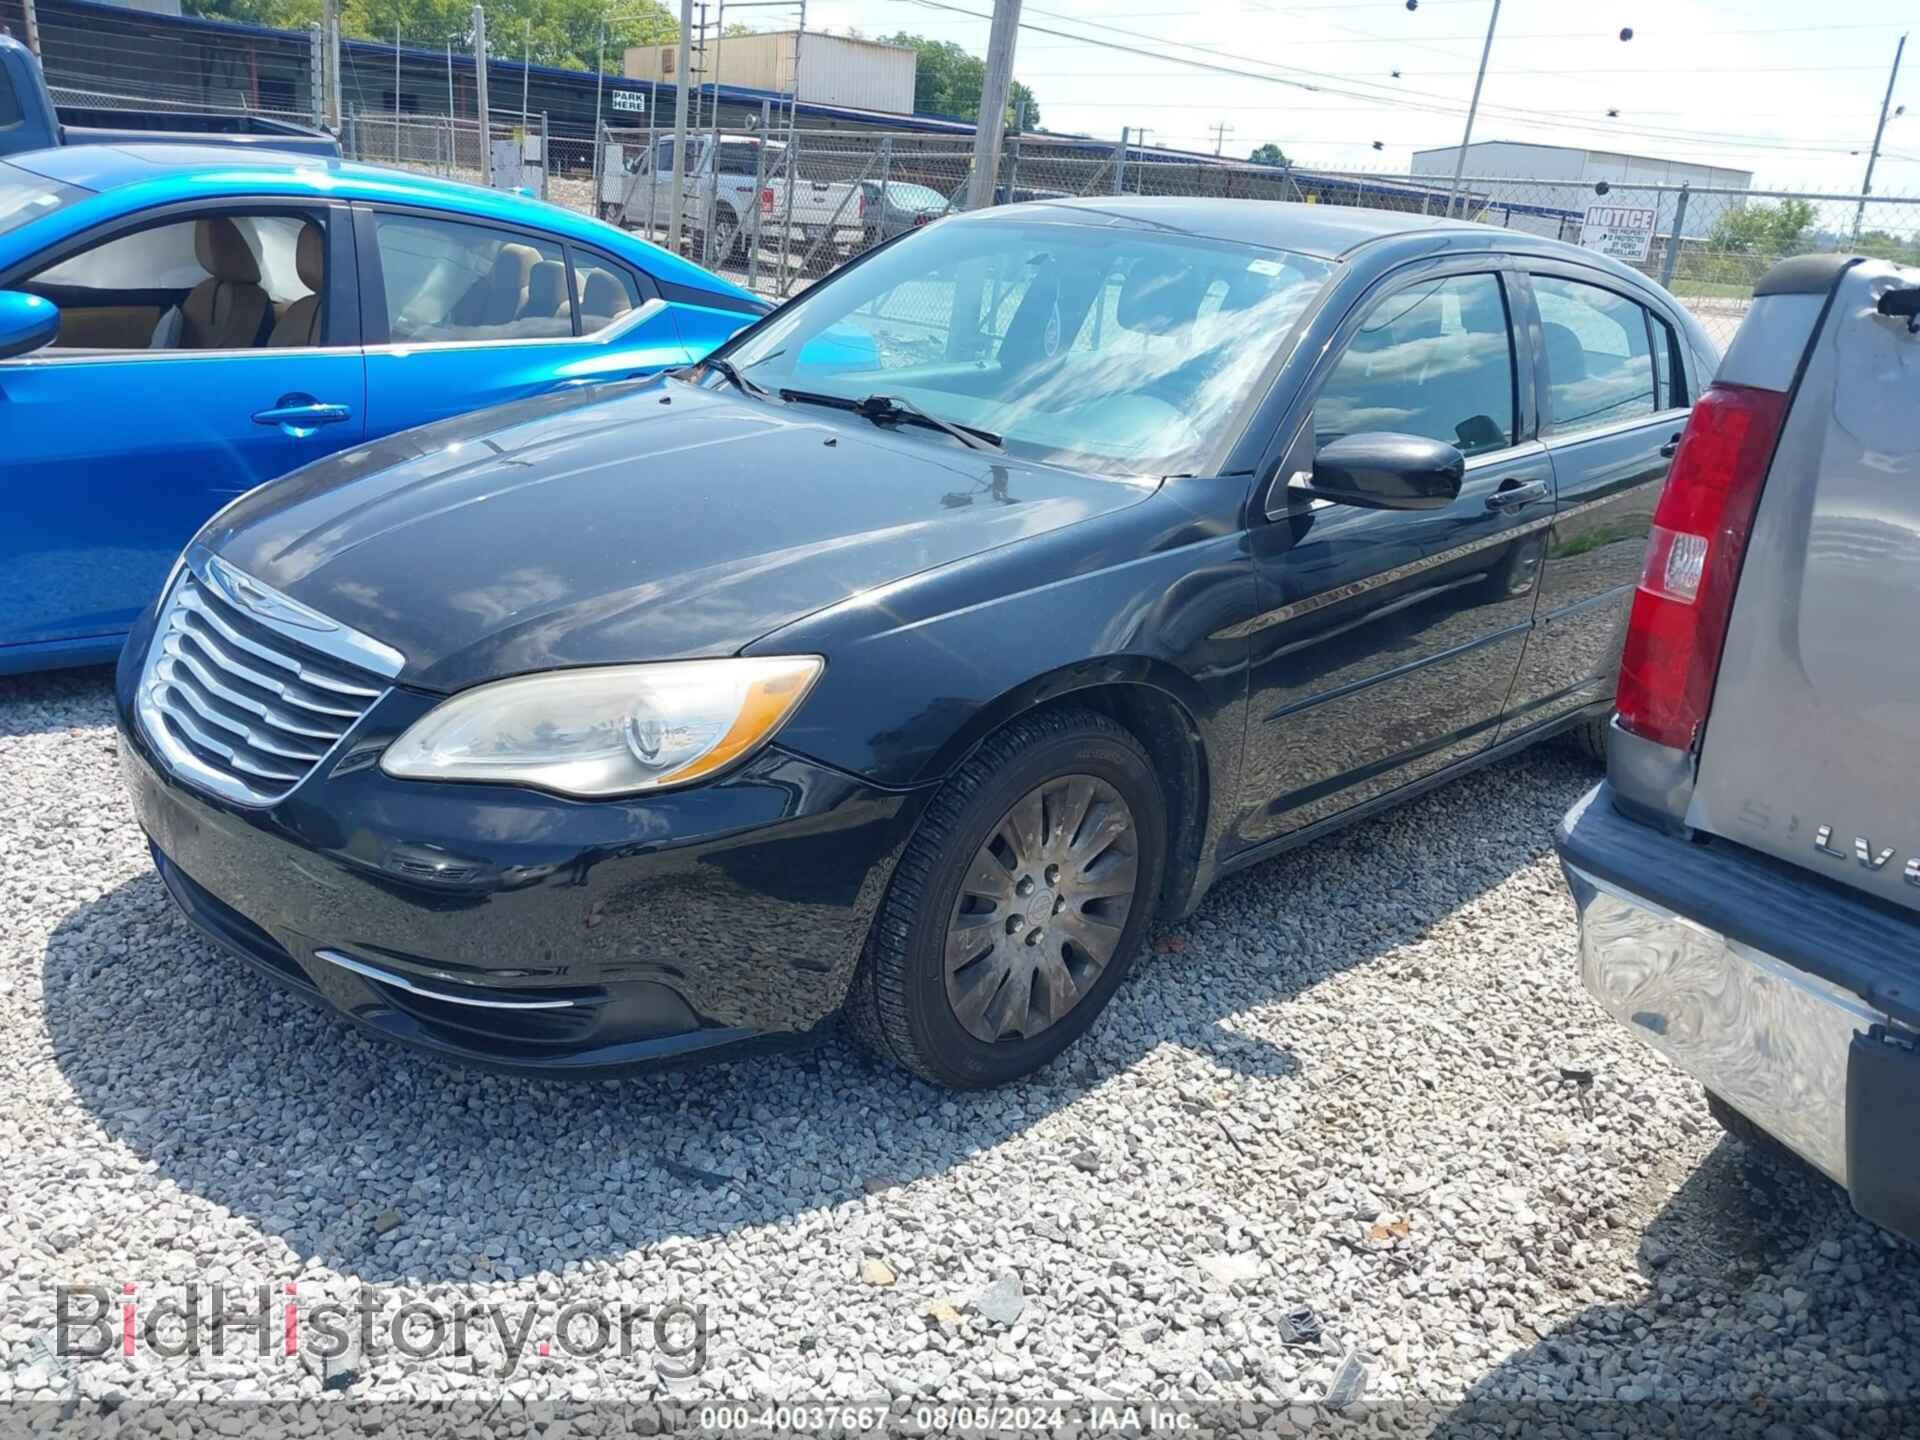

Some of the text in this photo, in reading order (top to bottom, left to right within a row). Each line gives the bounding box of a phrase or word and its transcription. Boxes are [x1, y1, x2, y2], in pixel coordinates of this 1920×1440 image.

[614, 91, 642, 101] PARK
[614, 100, 644, 110] HERE
[1587, 207, 1653, 229] NOTICE
